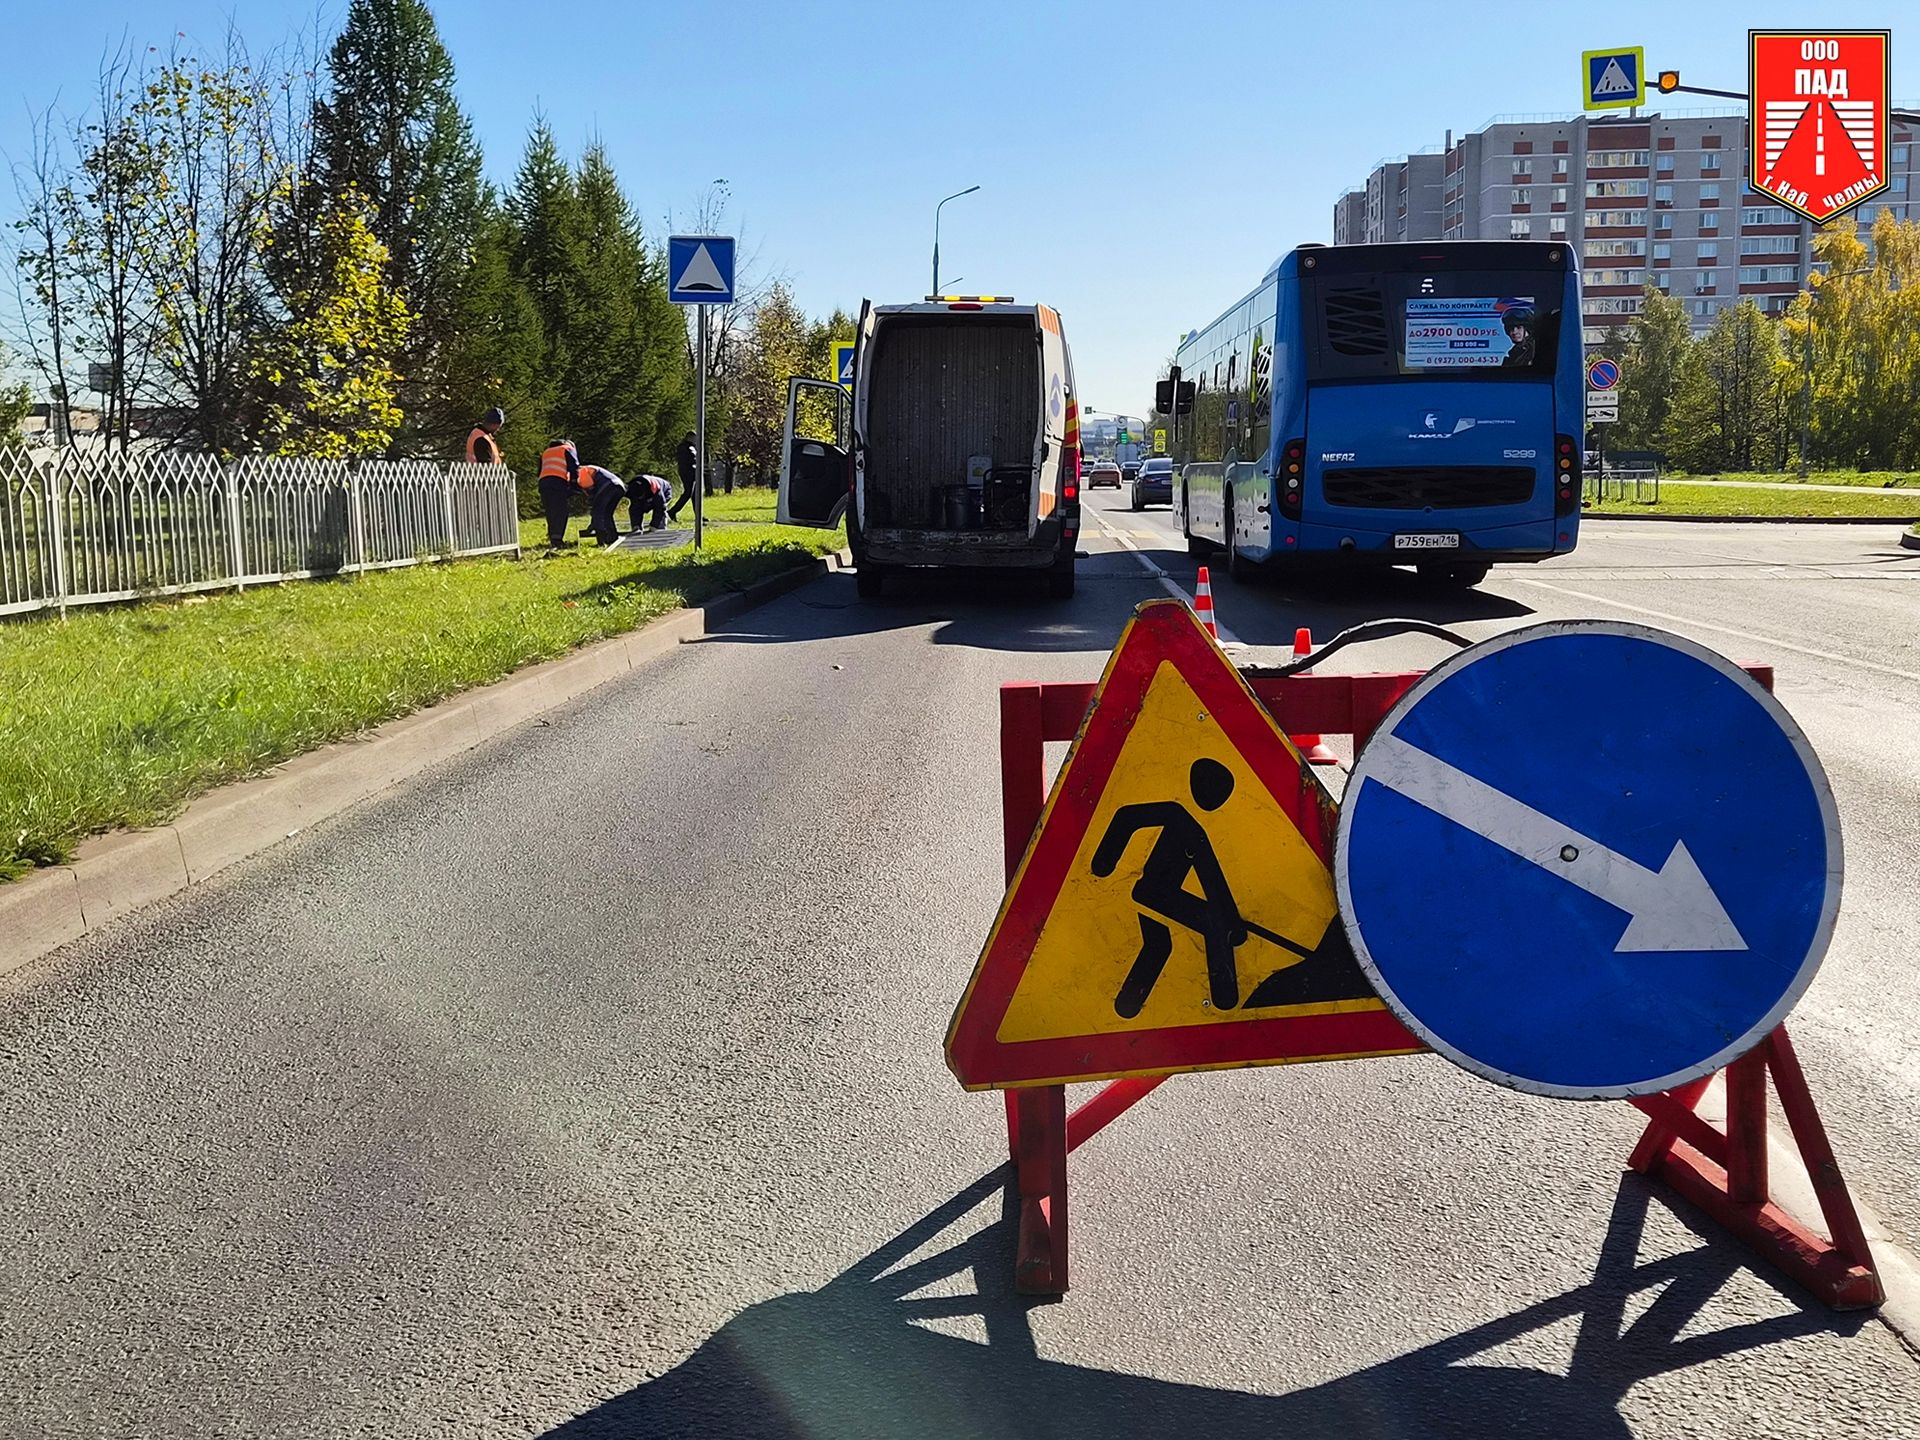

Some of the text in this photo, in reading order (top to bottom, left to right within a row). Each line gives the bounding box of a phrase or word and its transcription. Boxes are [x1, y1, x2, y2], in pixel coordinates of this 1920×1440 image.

[1408, 327, 1500, 338] ДО 2900 000 РУБ.
[1322, 453, 1356, 462] NEFAZ
[1503, 449, 1537, 459] 5299
